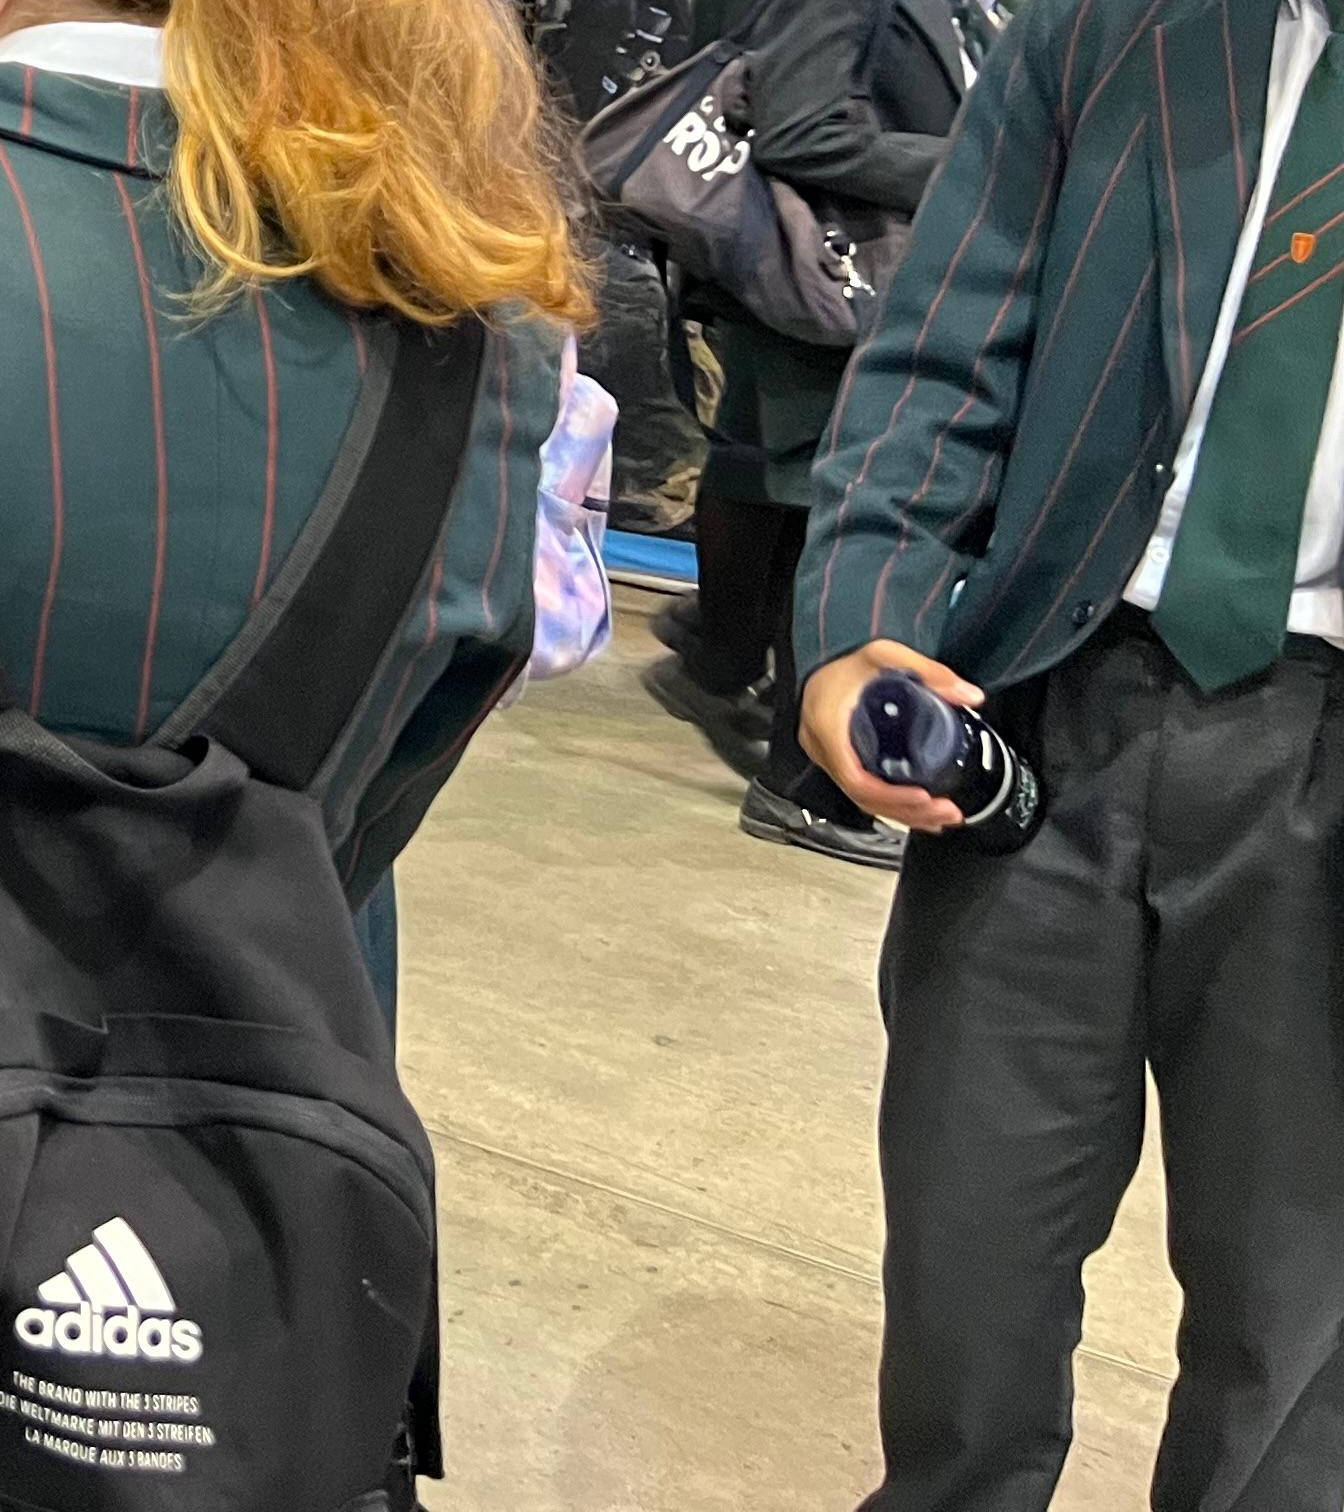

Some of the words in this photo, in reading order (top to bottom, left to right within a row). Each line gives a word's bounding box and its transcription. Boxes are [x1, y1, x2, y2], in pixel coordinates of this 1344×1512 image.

[15, 1300, 203, 1363] adidas
[13, 1370, 36, 1393] THE
[38, 1380, 82, 1406] BRAND
[85, 1390, 116, 1408] WITH
[120, 1392, 140, 1410] THE
[153, 1394, 199, 1413] STRIPES
[20, 1399, 95, 1436] WELTMARKE
[98, 1420, 120, 1437] MIT
[123, 1421, 144, 1438] DEN
[156, 1423, 214, 1445] STREIFEN
[25, 1426, 40, 1444] LA
[43, 1433, 96, 1463] MARQUE
[99, 1449, 125, 1467] AUX
[138, 1451, 184, 1471] BANDES
